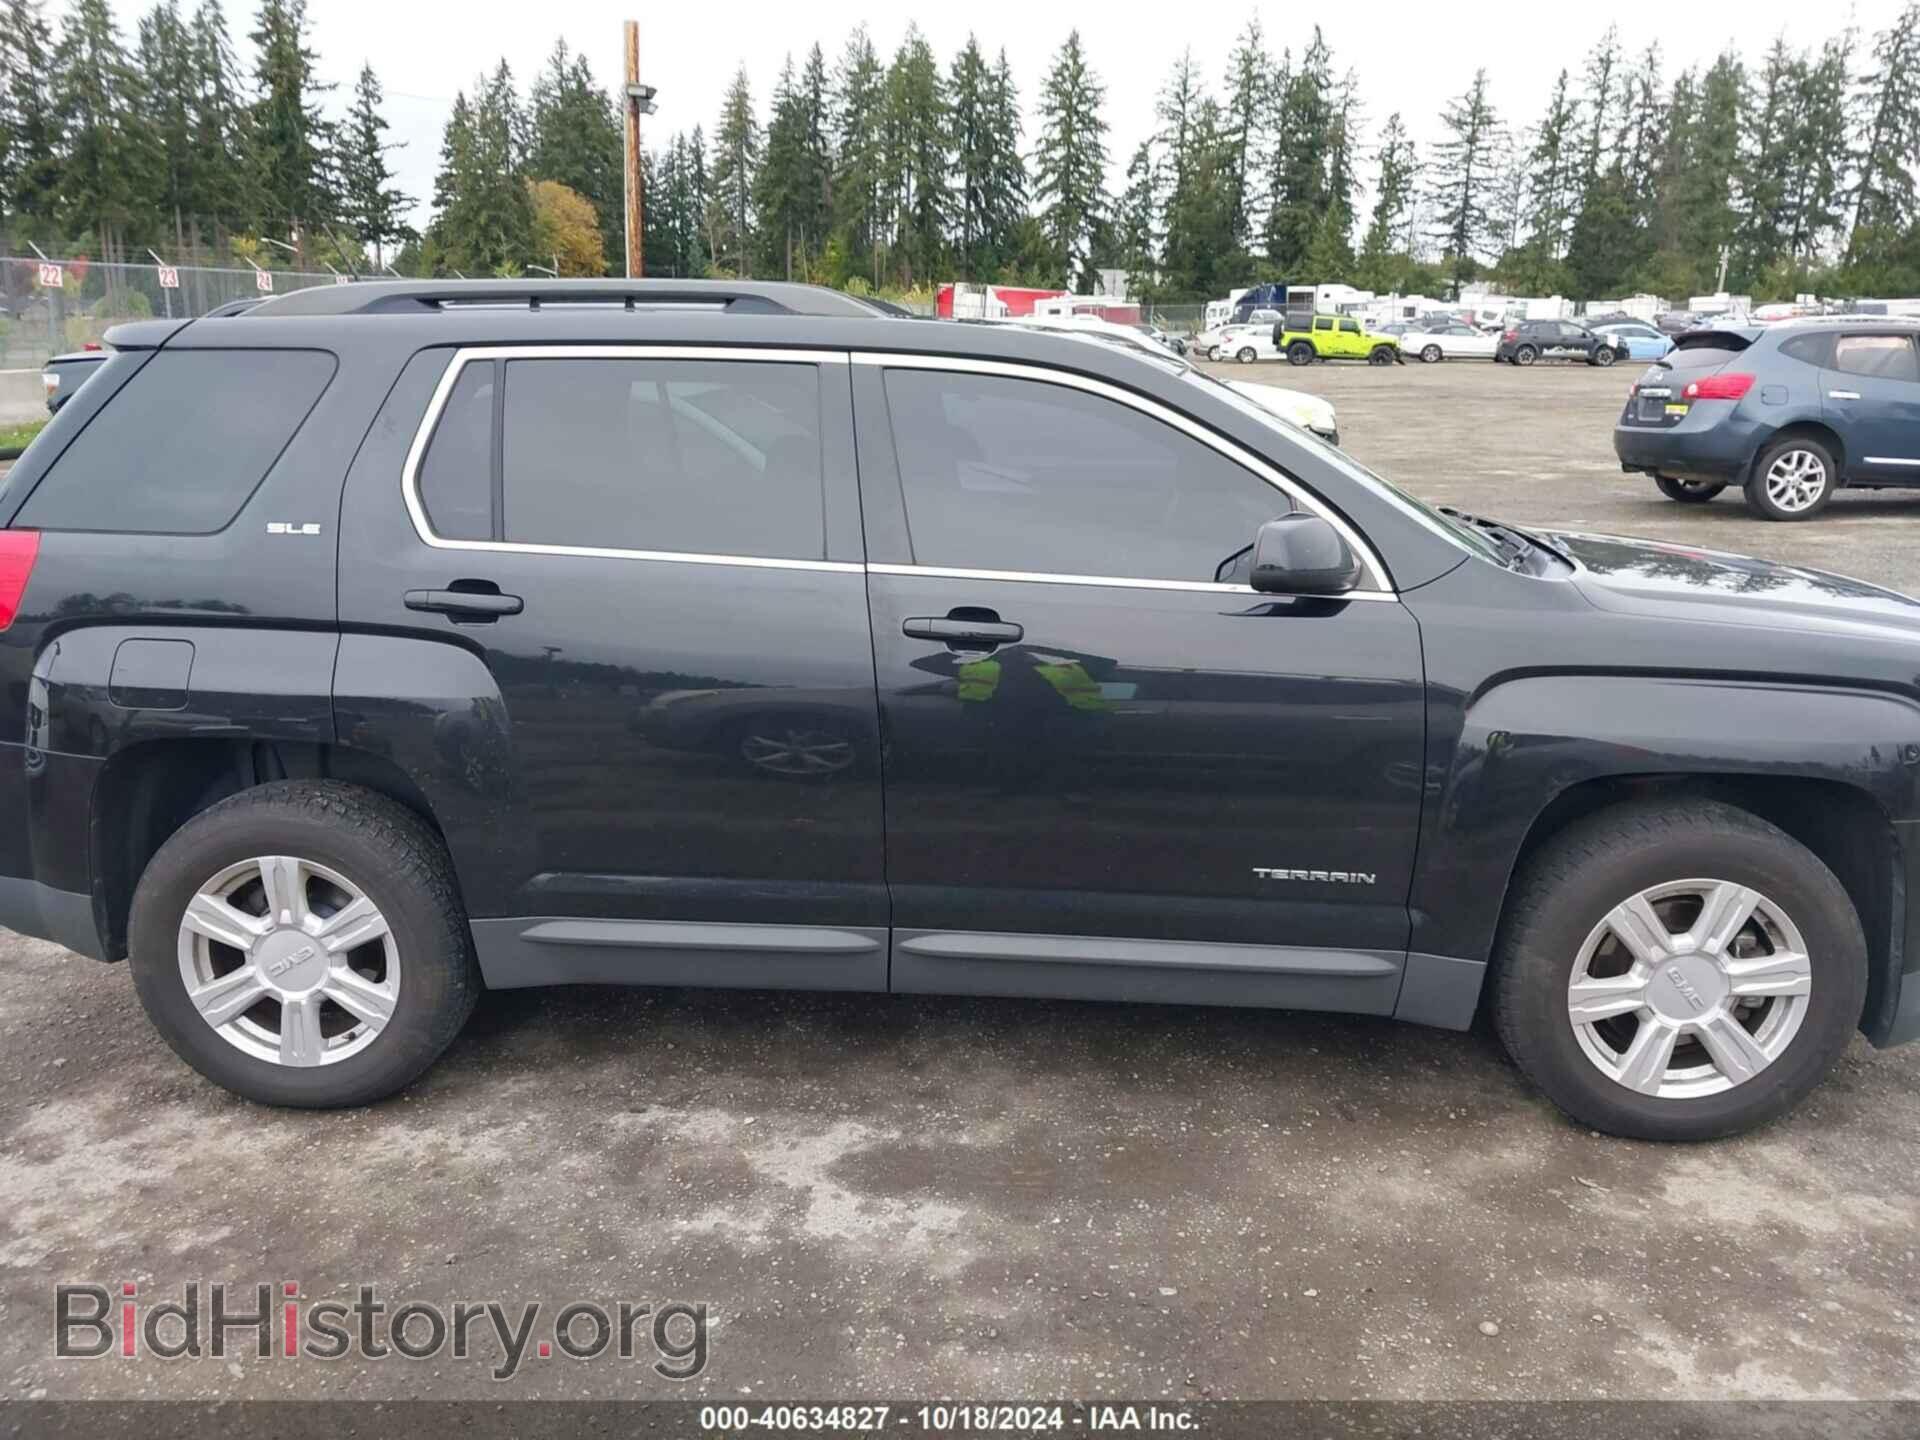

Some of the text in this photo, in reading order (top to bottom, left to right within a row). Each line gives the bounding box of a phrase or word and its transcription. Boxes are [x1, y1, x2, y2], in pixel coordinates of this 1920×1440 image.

[42, 265, 60, 284] 22
[160, 269, 177, 286] 23
[258, 273, 271, 289] 24
[266, 522, 321, 535] SLE
[1252, 867, 1377, 885] TERRAIN
[269, 945, 315, 978] GMC
[1666, 966, 1705, 1011] GMC
